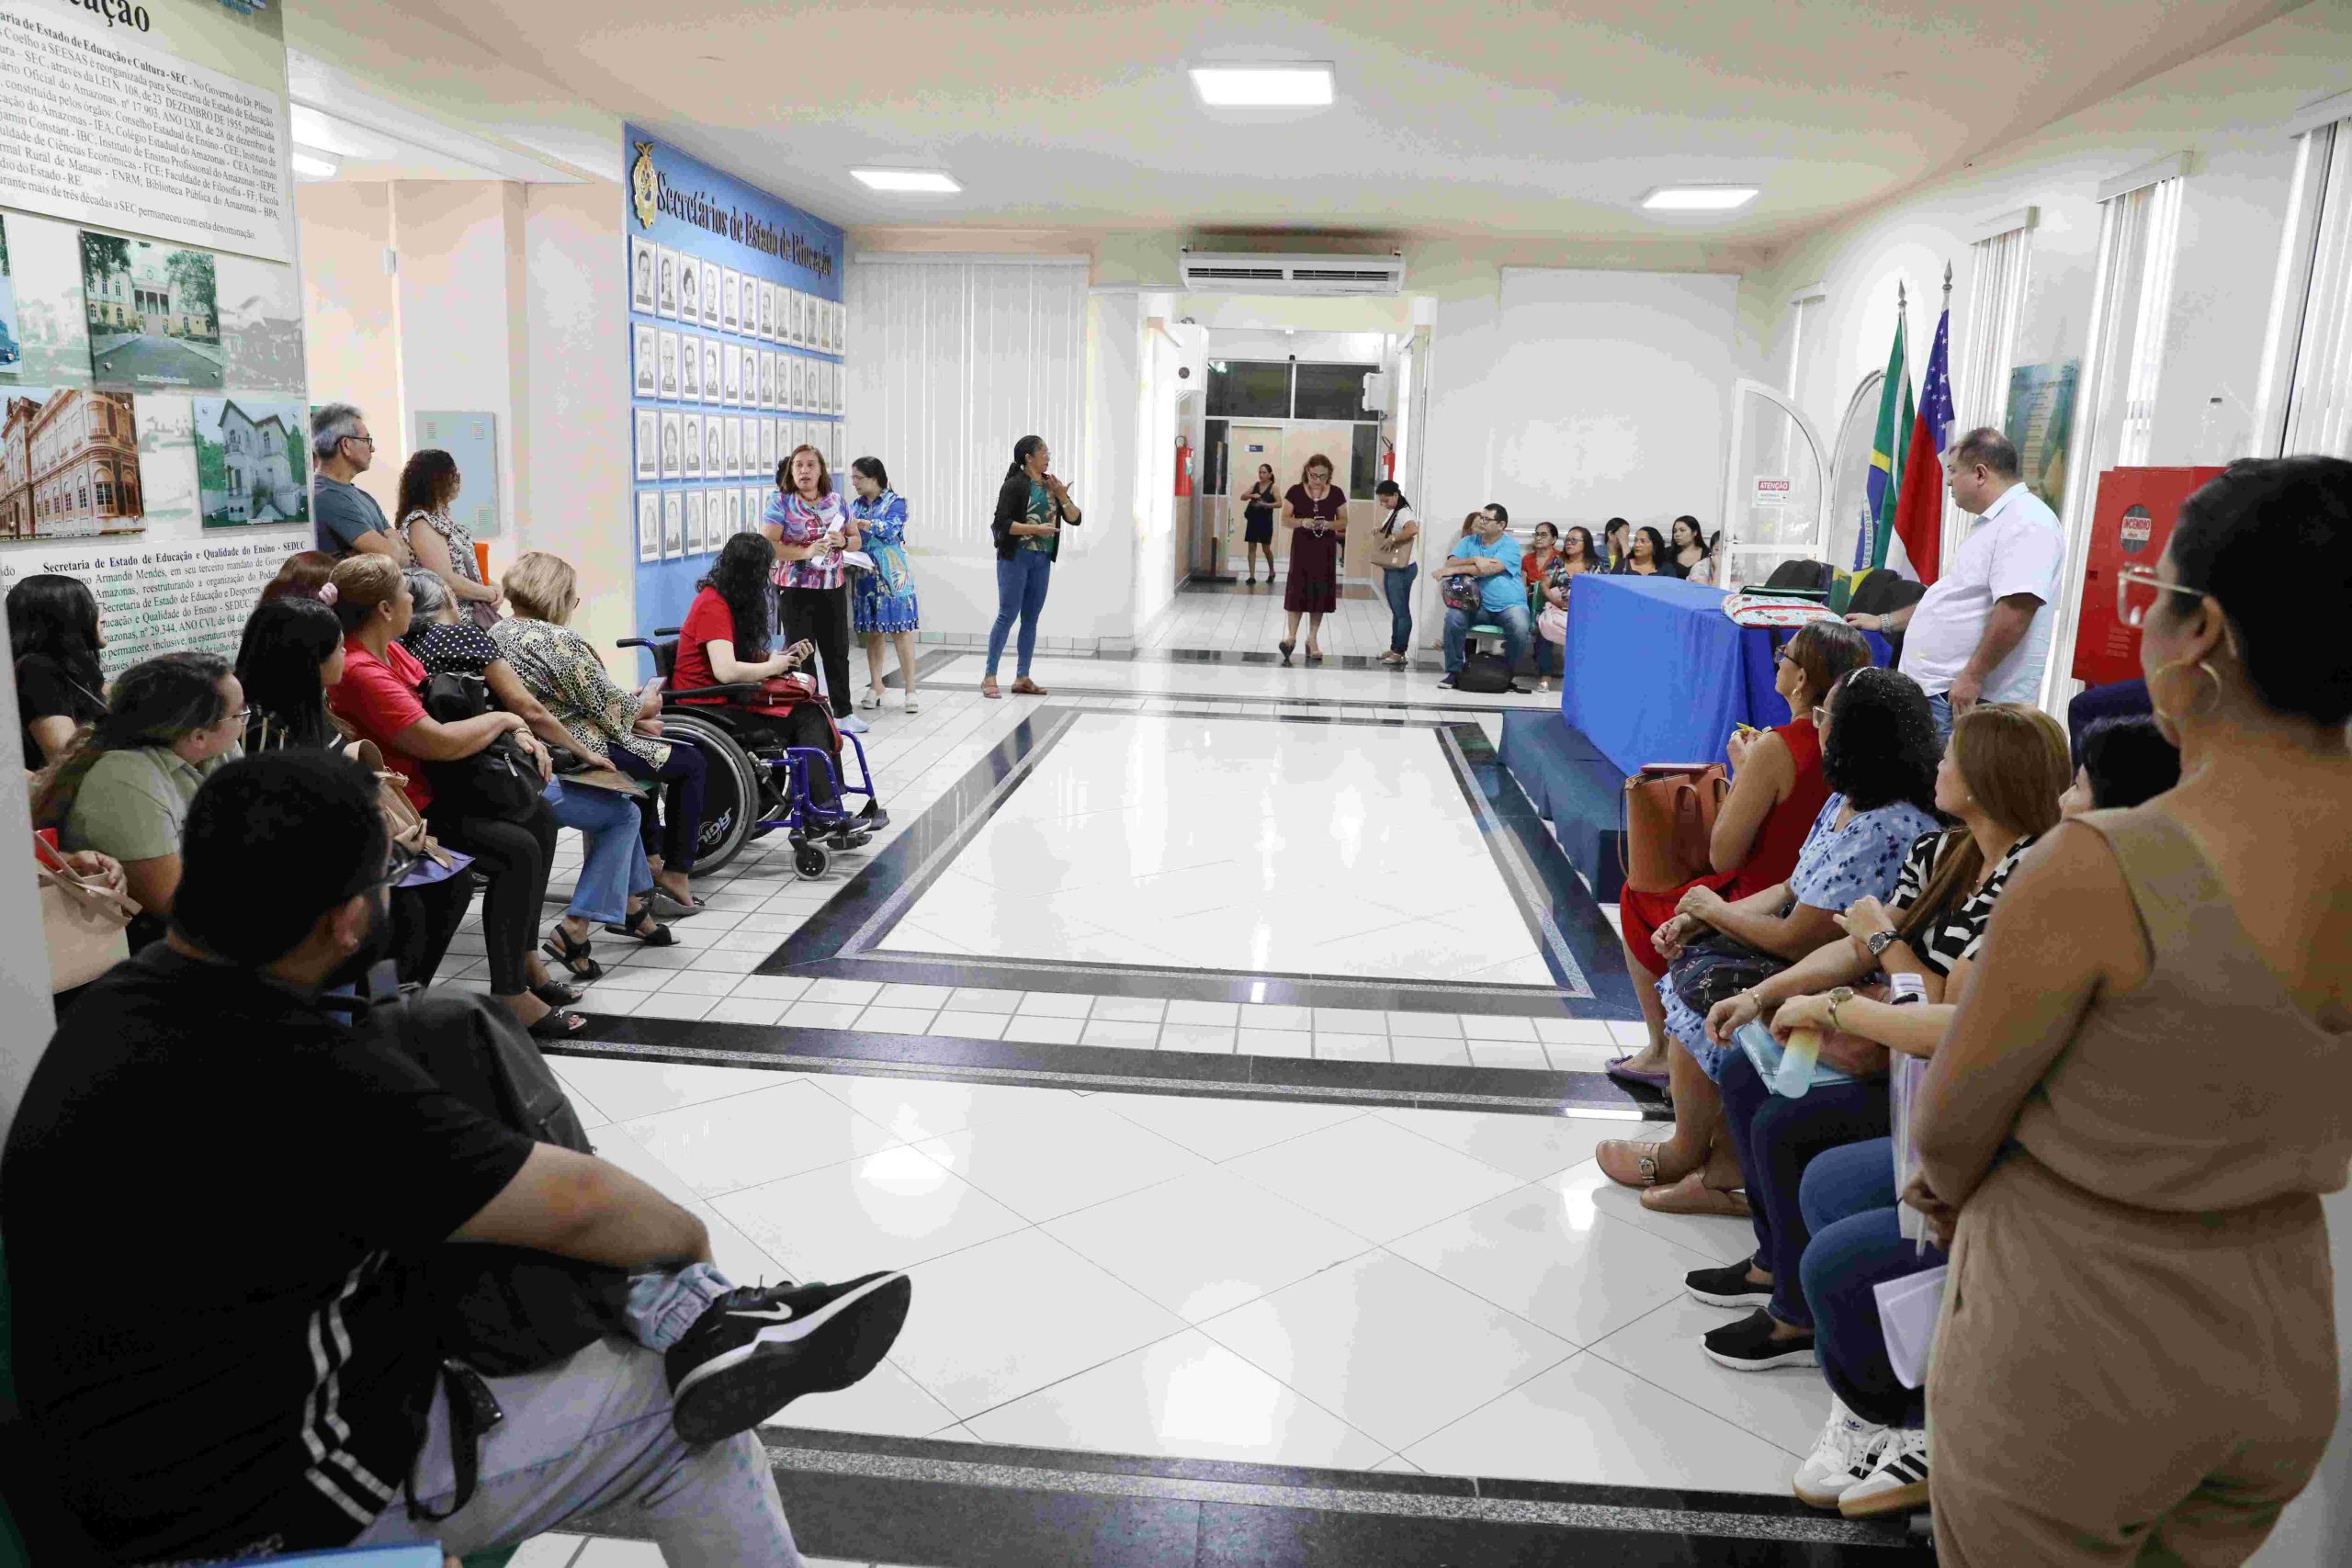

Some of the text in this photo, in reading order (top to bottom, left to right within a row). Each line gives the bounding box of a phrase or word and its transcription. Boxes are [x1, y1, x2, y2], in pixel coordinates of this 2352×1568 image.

[5, 29, 38, 49] Coelho
[49, 44, 87, 65] SEESAS
[96, 62, 147, 85] reorganizada
[149, 80, 164, 91] para
[166, 84, 201, 103] Secretaria
[212, 99, 234, 114] Estado
[244, 110, 273, 127] Educação
[23, 19, 33, 31] de
[37, 24, 69, 43] Estado
[71, 36, 81, 48] de
[84, 40, 126, 63] Educação
[133, 58, 165, 77] Cultura
[171, 71, 188, 85] SEC
[24, 68, 55, 86] Oficial
[59, 79, 70, 90] do
[163, 111, 181, 125] ANO
[206, 124, 213, 135] de
[216, 127, 224, 138] 28
[227, 131, 234, 141] de
[236, 134, 266, 151] dezembro
[51, 63, 81, 79] através
[84, 71, 94, 83] da
[143, 90, 151, 101] de
[153, 93, 161, 104] 23
[166, 98, 212, 121] DEZEMBRO
[215, 114, 225, 125] DE
[28, 101, 38, 112] do
[42, 105, 87, 126] Amazonas
[116, 126, 146, 143] Colégio
[149, 135, 179, 152] Estadual
[181, 145, 189, 155] do
[191, 148, 225, 165] Amazonas
[59, 97, 81, 109] pelos
[115, 111, 151, 130] Conselho
[154, 123, 183, 140] Estadual
[186, 132, 193, 142] de
[196, 135, 218, 150] Ensino
[17, 162, 28, 173] do
[31, 165, 60, 181] Estado
[29, 117, 69, 137] Constant
[100, 136, 132, 153] Instituto
[134, 146, 142, 156] de
[145, 149, 169, 164] Ensino
[213, 167, 222, 177] do
[223, 170, 255, 187] Amazonas
[35, 135, 45, 146] de
[166, 169, 200, 186] Faculdade
[203, 179, 210, 189] de
[213, 182, 241, 197] Filosofia
[26, 148, 50, 163] Rural
[55, 155, 64, 167] de
[69, 159, 102, 176] Manaus
[146, 178, 182, 195] Biblioteca
[214, 195, 222, 205] do
[224, 198, 256, 213] Amazonas
[29, 184, 49, 194] mais
[52, 186, 61, 197] de
[81, 193, 112, 208] décadas
[120, 201, 137, 213] SEC
[139, 208, 181, 223] permaneceu
[183, 218, 198, 227] com
[199, 221, 211, 230] esta
[657, 172, 831, 279] Secretários de Estado de Educação
[1759, 480, 1788, 491] ATENÇÃO
[43, 541, 305, 573] Secretaria de Estado de Educação Qualidade do Ensino SEDUC
[1863, 510, 1873, 566] PROGRESSO
[95, 588, 138, 599] Amazonas,
[143, 579, 194, 593] reestruturando
[207, 573, 246, 588] organização
[248, 572, 256, 581] do
[96, 571, 132, 583] Armando
[227, 560, 253, 570] mandato
[256, 558, 263, 567] de
[143, 599, 151, 608] de
[154, 595, 178, 607] Estado
[180, 594, 188, 603] de
[191, 590, 222, 602] Educação
[143, 609, 179, 624] Qualidade
[183, 608, 191, 617] do
[194, 605, 217, 615] Ensino
[180, 620, 197, 632] ANO
[218, 616, 225, 626] de
[227, 614, 235, 624] 04
[238, 613, 244, 622] de
[198, 632, 226, 643] estrutura
